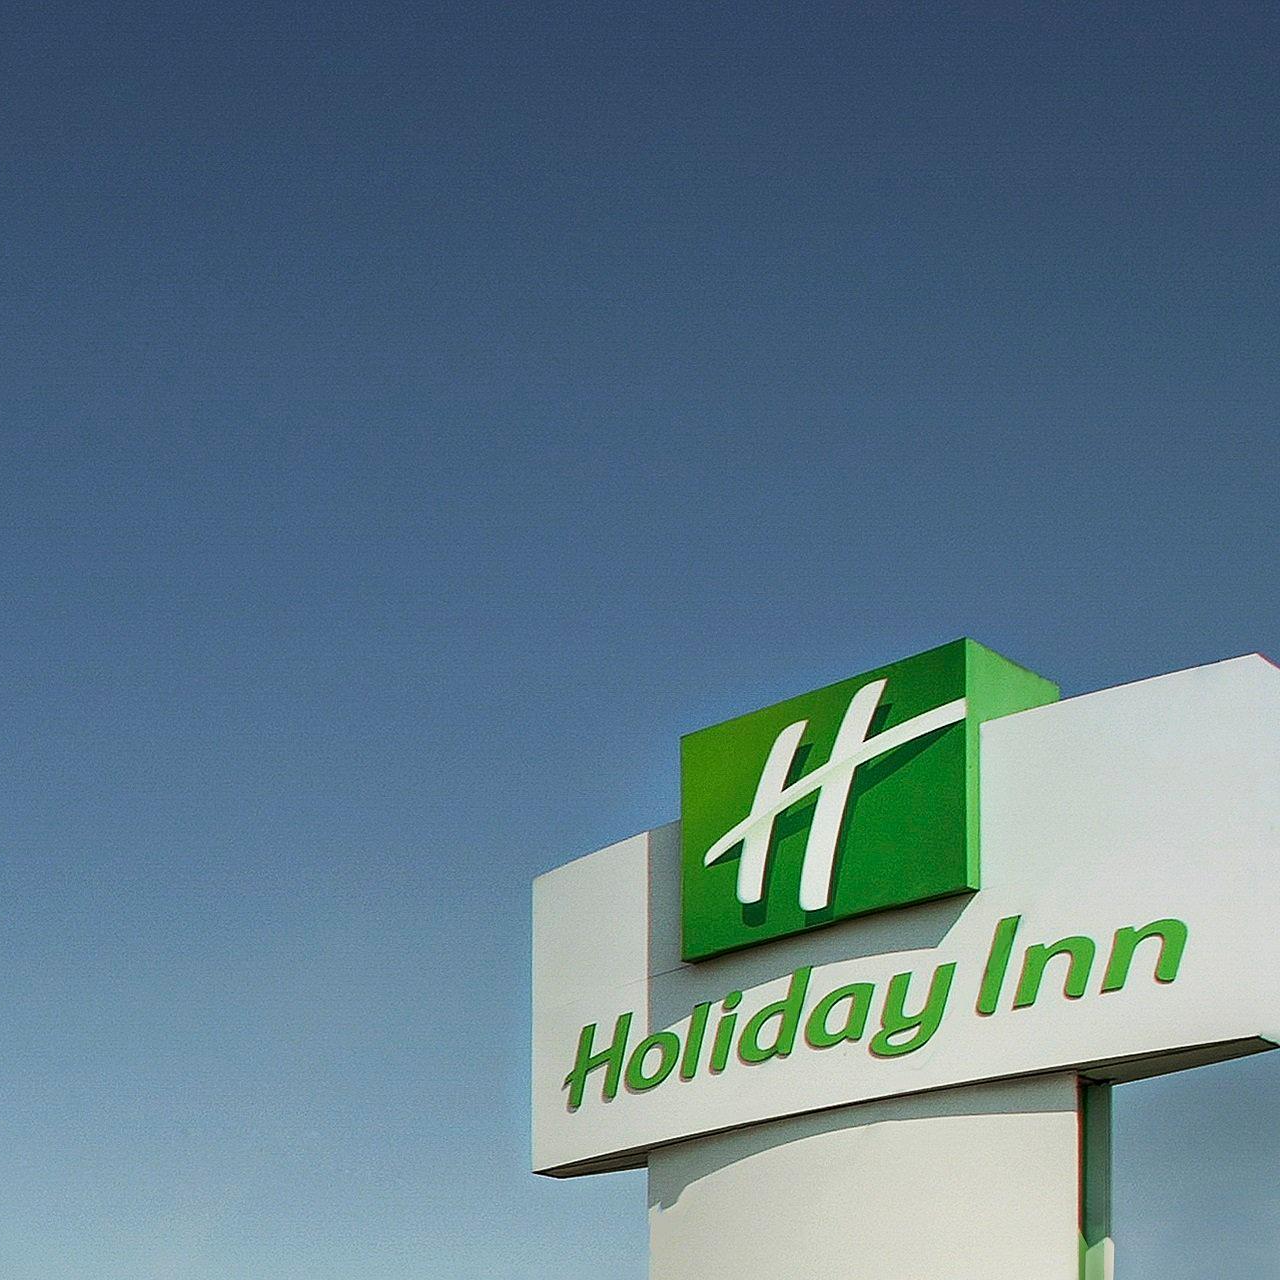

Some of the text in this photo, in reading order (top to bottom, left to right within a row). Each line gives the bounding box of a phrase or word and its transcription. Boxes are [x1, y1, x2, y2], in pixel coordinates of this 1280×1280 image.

[704, 679, 967, 911] H
[564, 914, 1190, 1110] Holiday Inn
